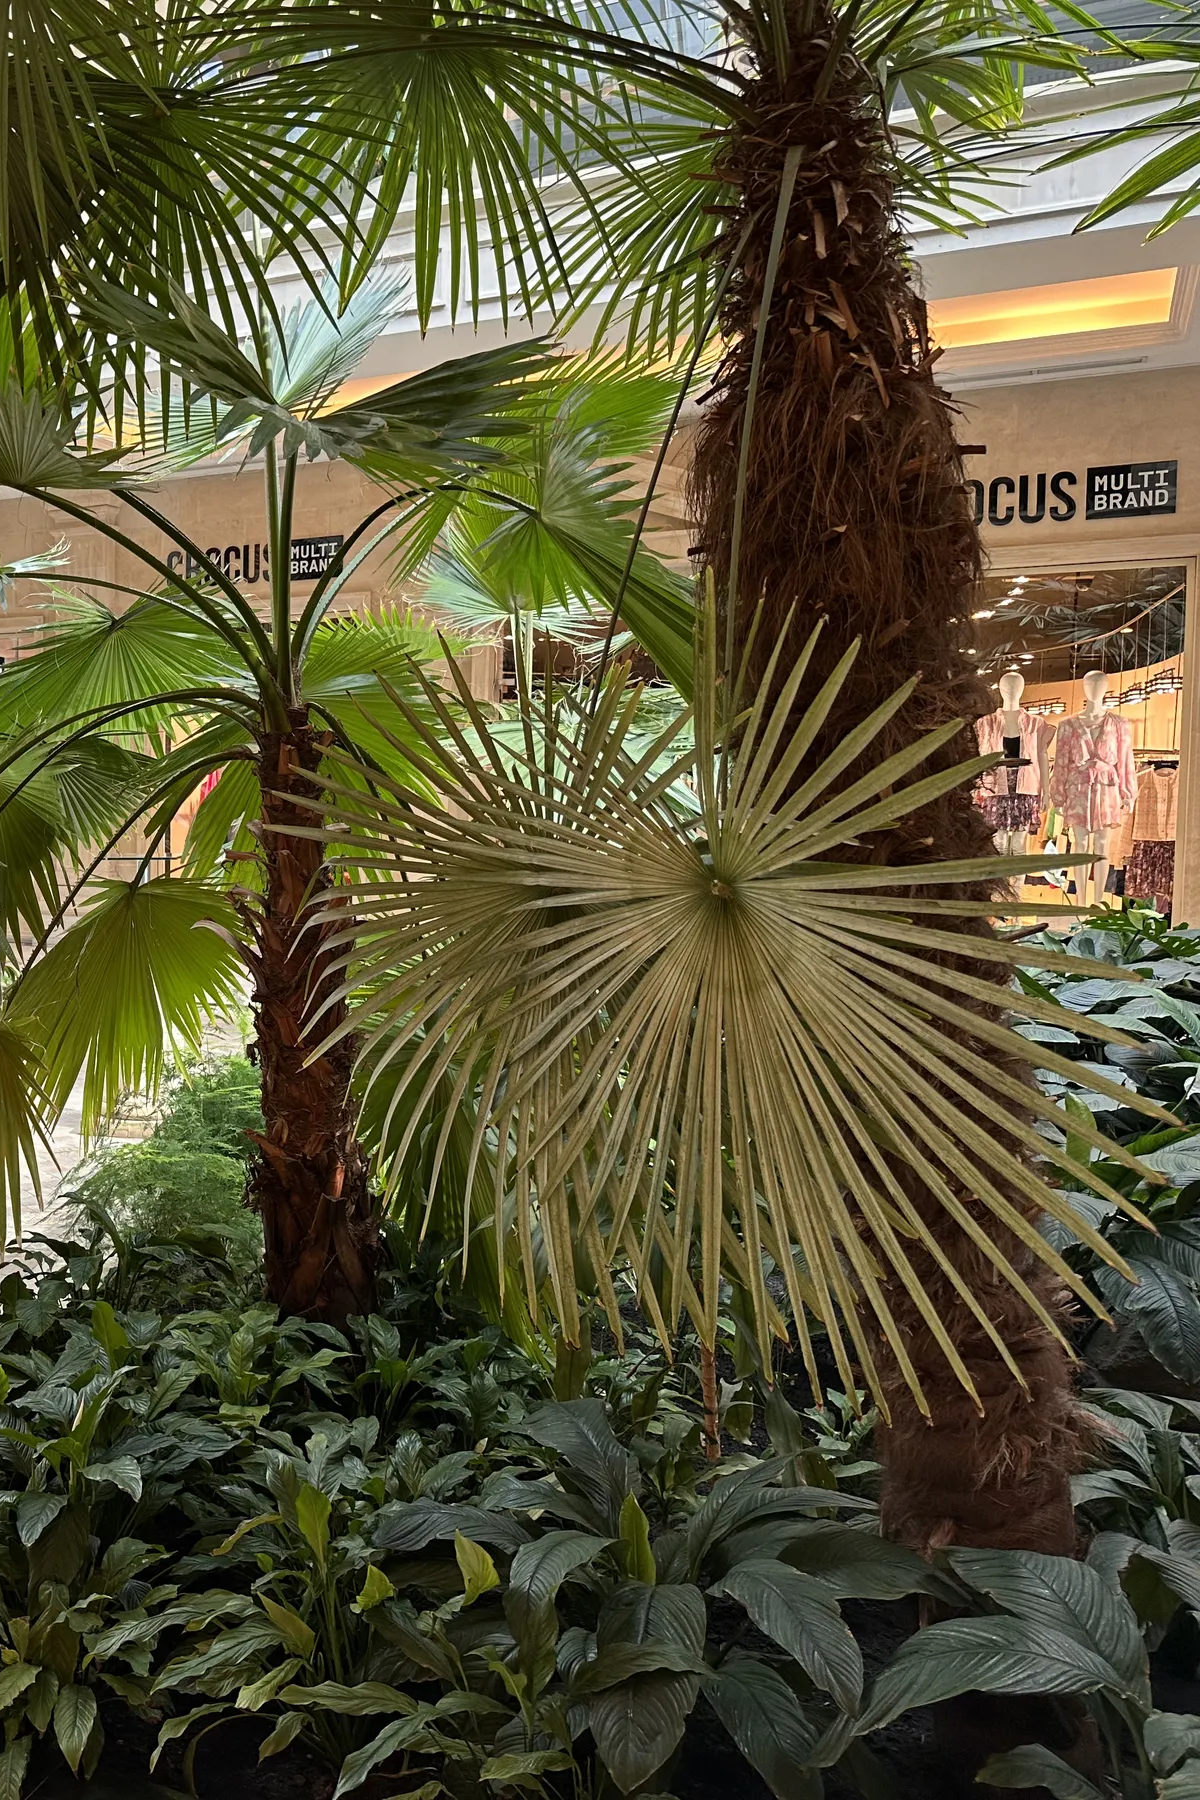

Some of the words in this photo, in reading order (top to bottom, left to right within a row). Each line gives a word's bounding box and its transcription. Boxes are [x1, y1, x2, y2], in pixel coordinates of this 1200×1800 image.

[1094, 470, 1169, 492] MULTI
[964, 471, 1077, 527] OCUS
[1094, 489, 1169, 511] BRAND
[290, 542, 338, 560] MULTI
[290, 557, 334, 575] BRAN
